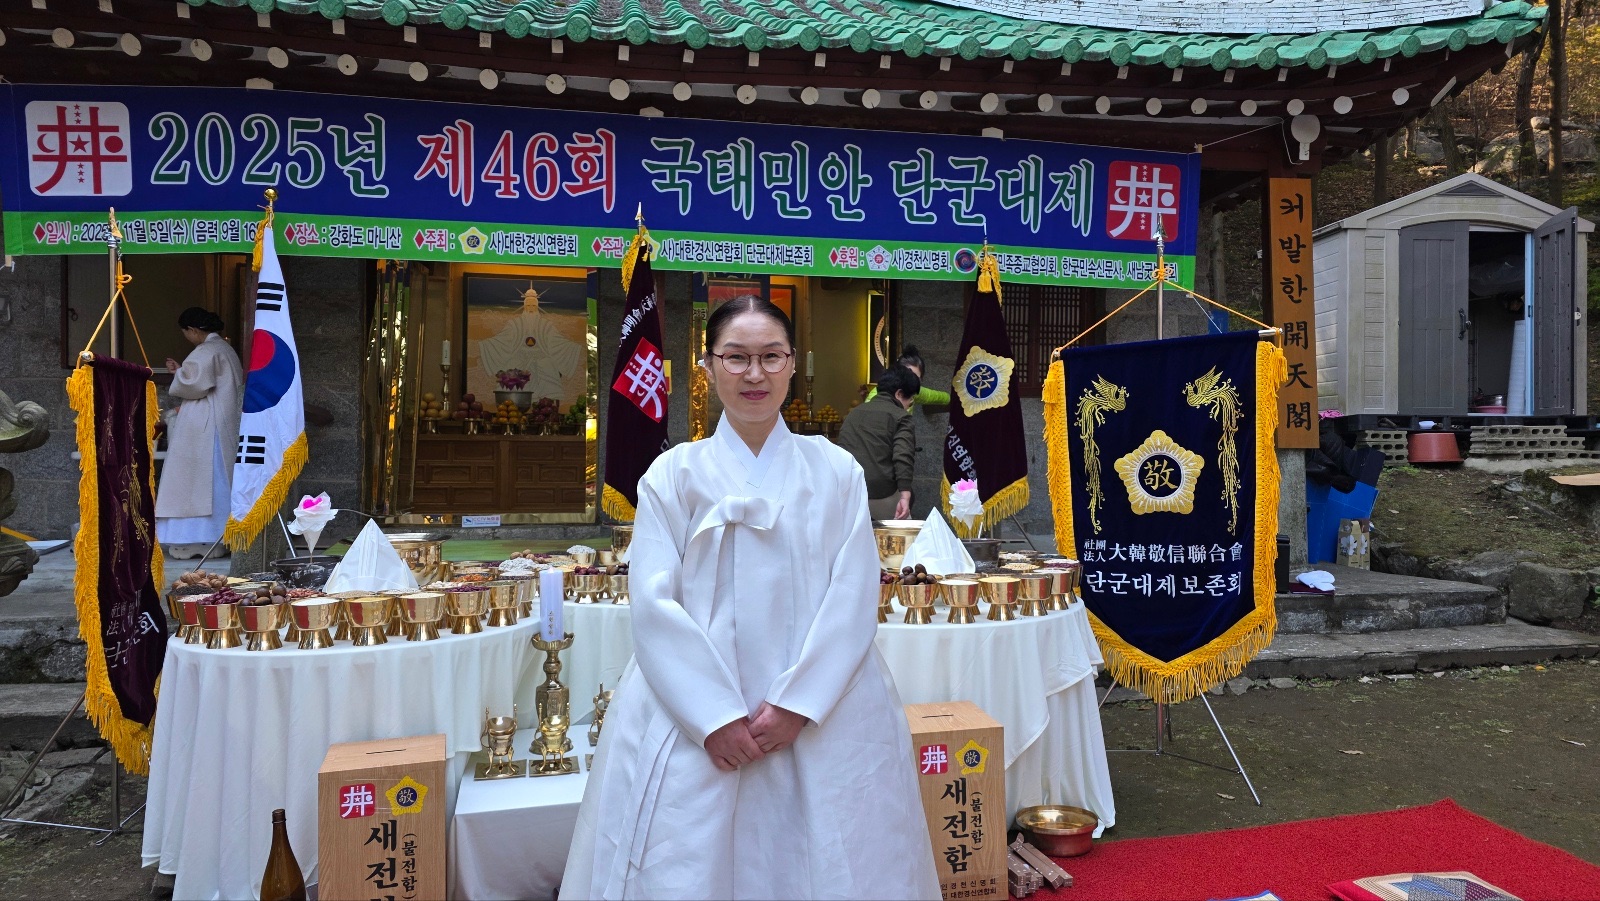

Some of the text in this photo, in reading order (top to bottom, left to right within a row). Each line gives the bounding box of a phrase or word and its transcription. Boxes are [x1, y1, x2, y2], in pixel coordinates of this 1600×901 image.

[148, 111, 1094, 237] 2025년 제46회 국태민안 단군대제
[80, 222, 121, 242] 2025
[123, 220, 147, 243] 11월
[150, 220, 188, 243] 5일(수)
[191, 220, 218, 243] (음력
[221, 219, 242, 243] 9월
[242, 221, 260, 242] 16
[329, 225, 364, 248] 강화도
[367, 226, 402, 249] 마니산
[490, 231, 579, 257] 사)대한경신연합회
[660, 239, 814, 267] 사)대한경신연합회 단군대제보존회
[891, 246, 1178, 282] 사)경천신명회, 민족종교협의회, 한국민속신문사, 새남굿회
[1085, 570, 1242, 599] 단군대제보존회
[940, 777, 973, 875] 새전함
